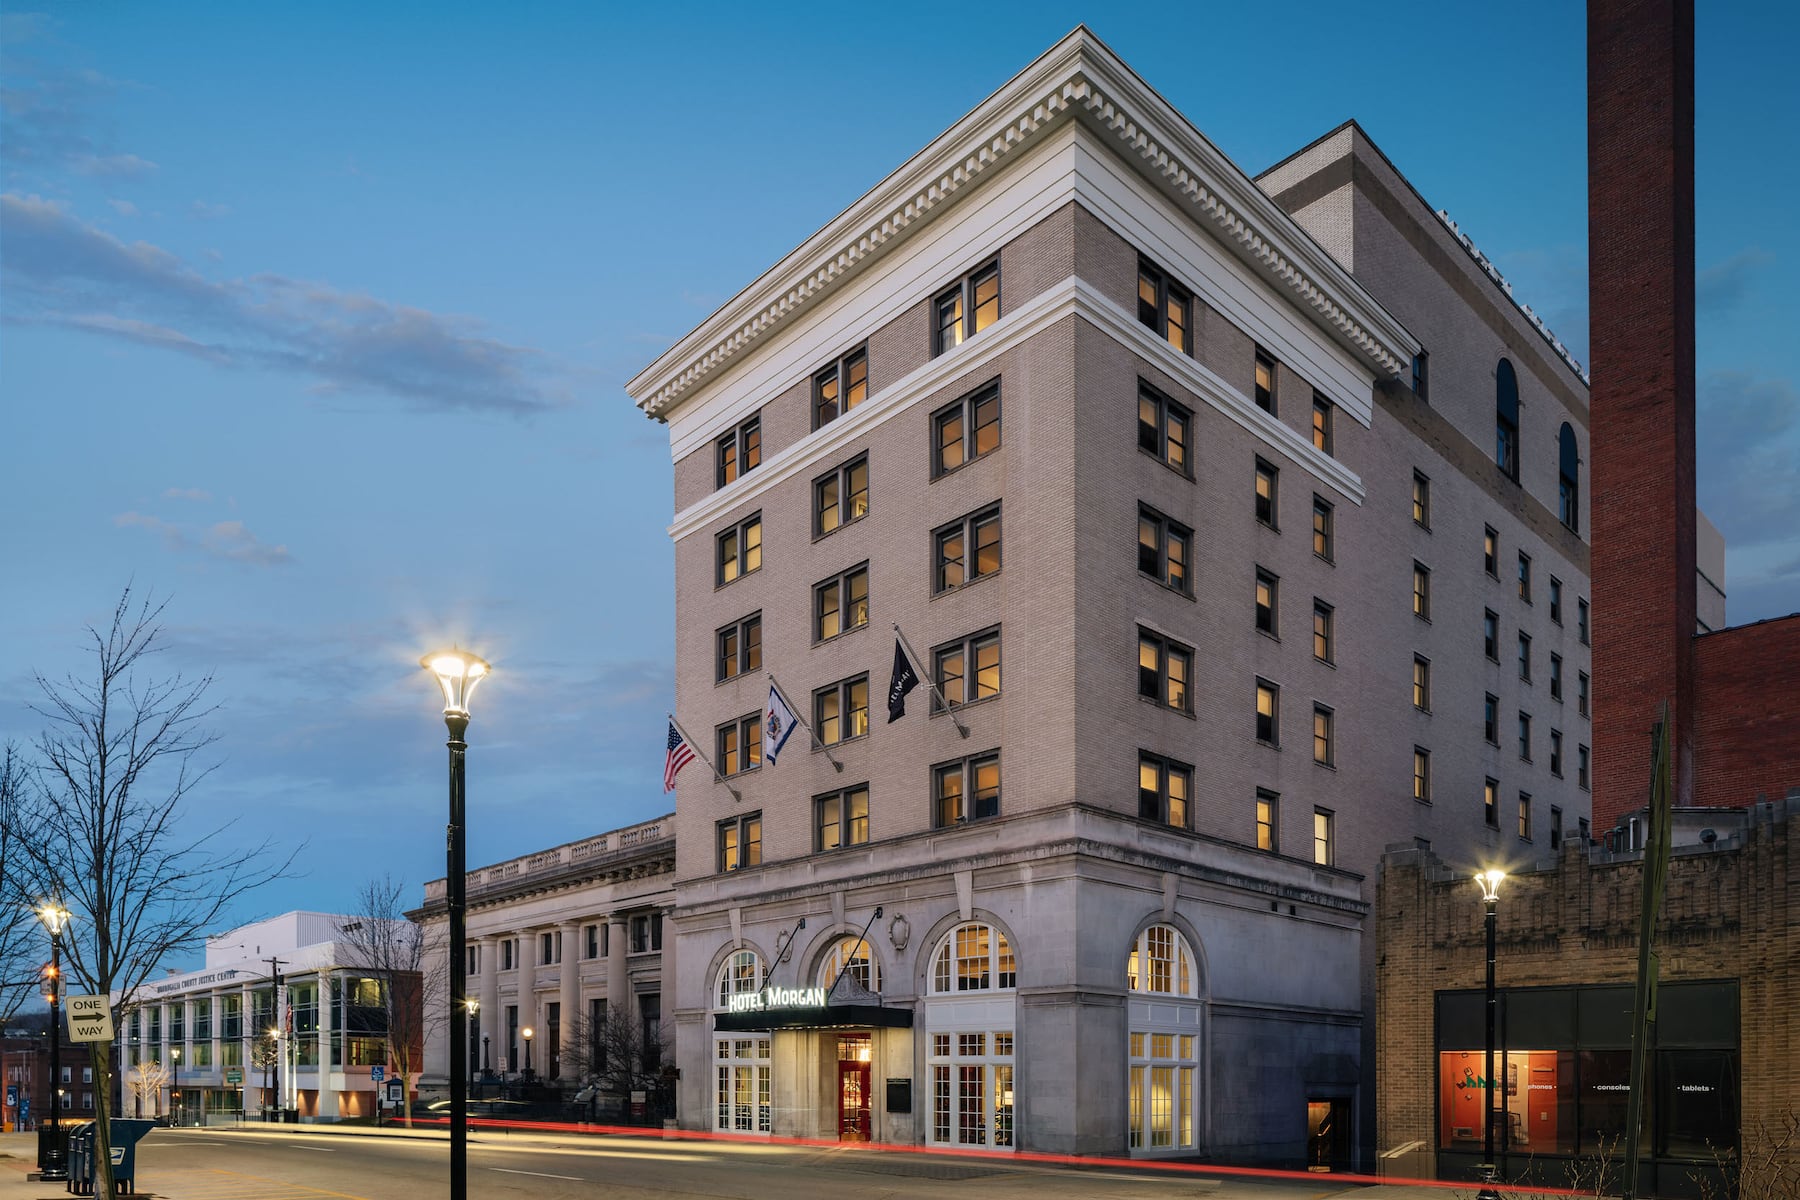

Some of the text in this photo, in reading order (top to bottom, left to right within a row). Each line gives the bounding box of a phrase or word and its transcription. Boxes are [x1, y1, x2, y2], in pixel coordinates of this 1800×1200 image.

[729, 987, 824, 1012] HOTEL MORGAN
[73, 1000, 102, 1010] ONE
[77, 1026, 103, 1036] WAY
